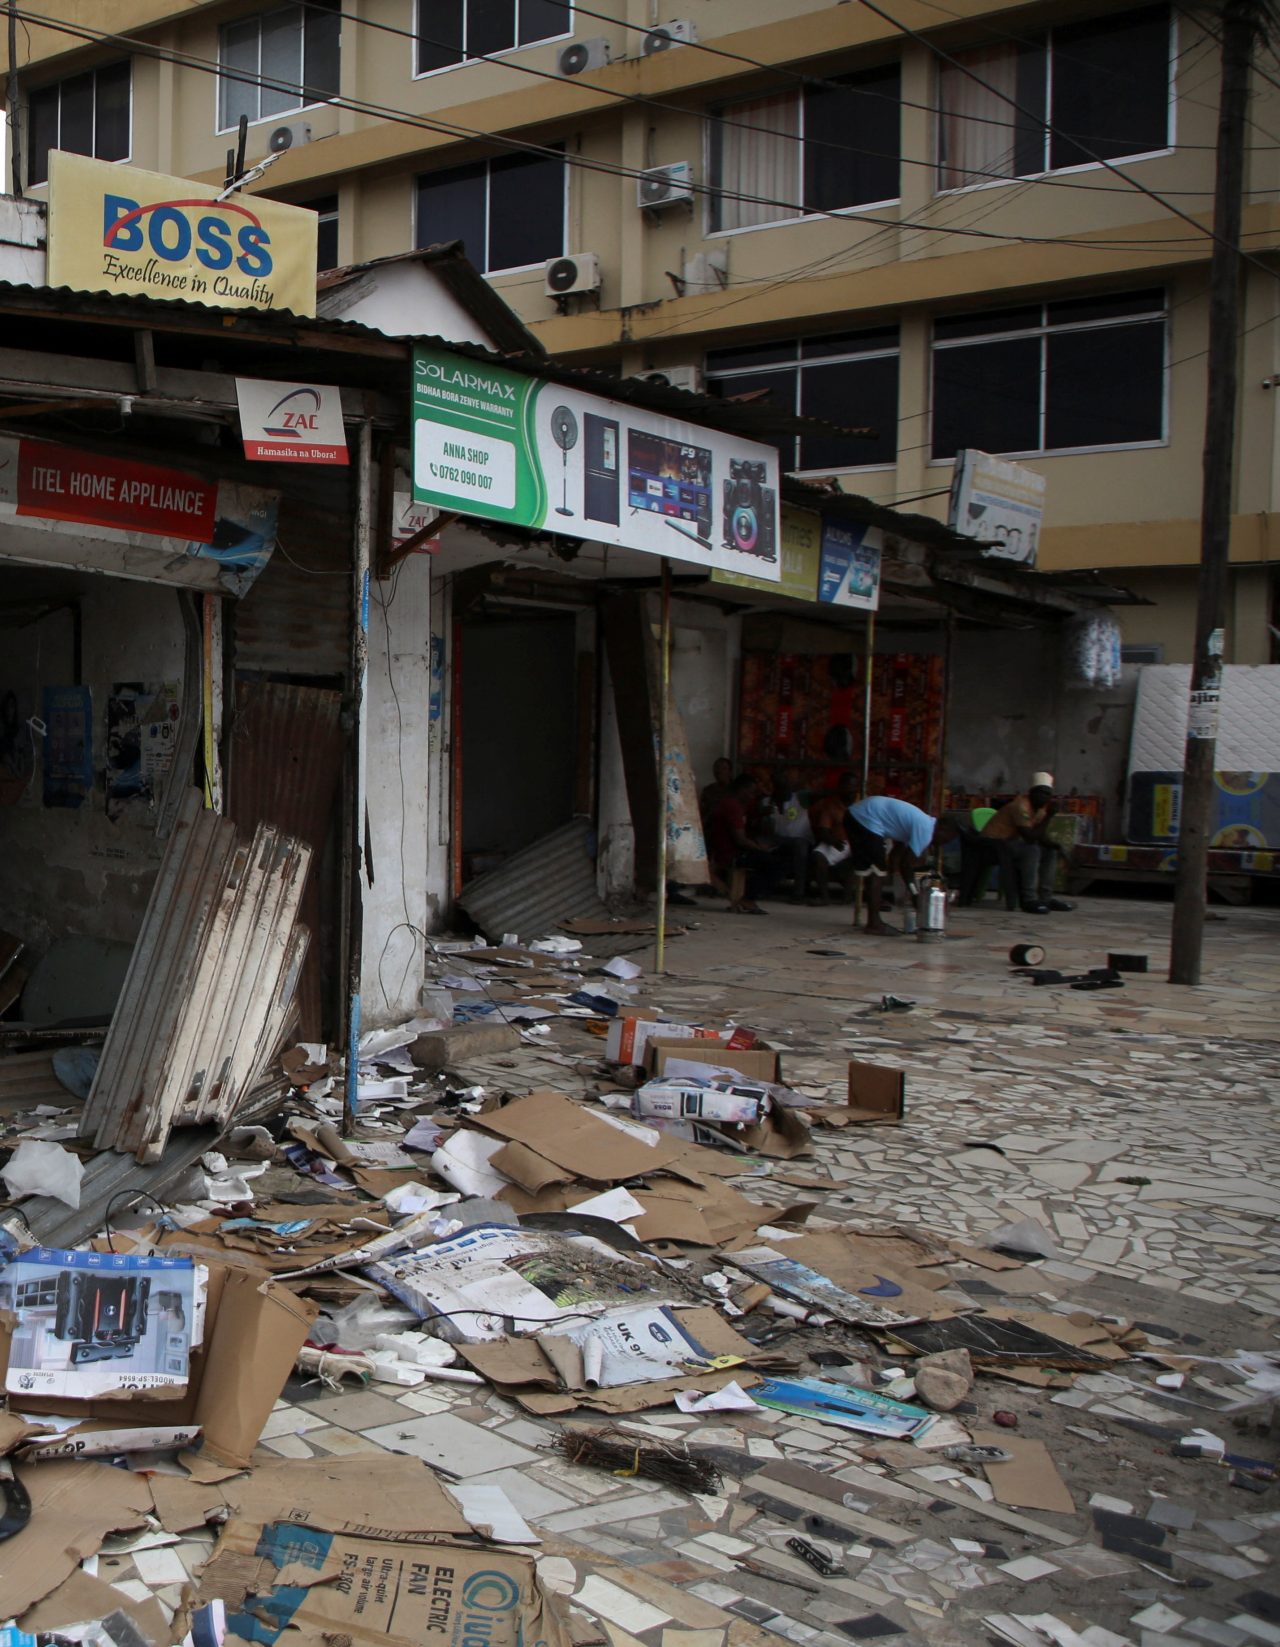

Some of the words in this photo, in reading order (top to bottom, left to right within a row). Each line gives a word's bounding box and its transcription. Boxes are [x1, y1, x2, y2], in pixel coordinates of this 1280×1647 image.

[103, 194, 274, 278] BOSS
[103, 254, 187, 291] Excellence
[190, 274, 208, 294] in
[213, 275, 275, 309] Quality
[415, 359, 516, 401] SOLARMAX
[441, 391, 460, 403] BORA
[460, 395, 480, 409] ZENYE
[282, 412, 319, 429] ZAC
[257, 446, 298, 457] Hamasika
[299, 450, 310, 458] na
[311, 450, 337, 459] Ubora!
[443, 442, 466, 461] ANNA
[467, 447, 489, 466] SHOP
[31, 466, 65, 493] ITEL
[70, 472, 117, 501] HOME
[119, 479, 205, 516] APPLIANCE
[439, 465, 459, 483] 0762
[461, 470, 477, 487] 090
[479, 475, 493, 490] 007
[617, 1322, 635, 1342] UK
[364, 1556, 378, 1579] large
[374, 1557, 393, 1604] Ultra-quiet
[410, 1562, 430, 1596] FAN
[426, 1565, 454, 1634] ELECTRIC
